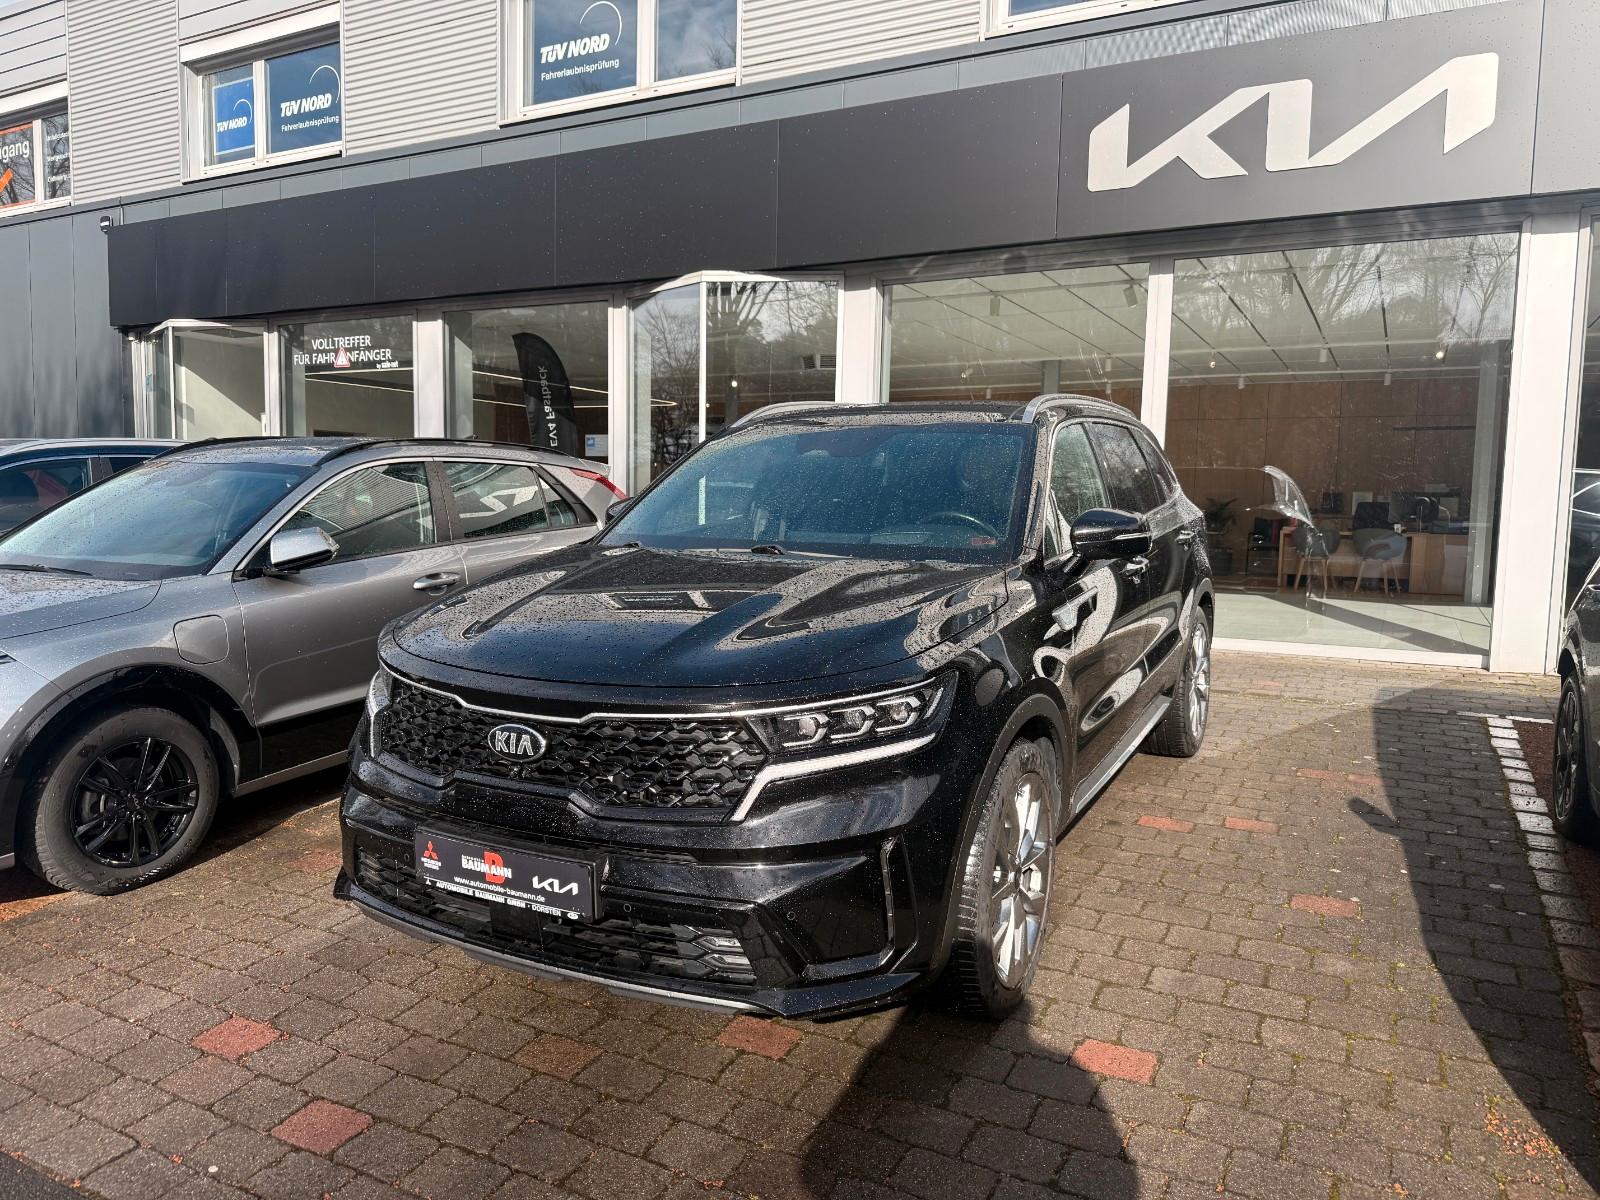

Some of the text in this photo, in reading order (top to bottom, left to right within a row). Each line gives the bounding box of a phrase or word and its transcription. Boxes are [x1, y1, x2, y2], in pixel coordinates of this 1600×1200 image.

[567, 34, 610, 58] NORD
[541, 59, 620, 81] Fahrerlaubnisprüfung
[300, 93, 332, 113] NORD
[228, 116, 248, 130] NORD
[281, 115, 340, 133] Fahrerlaubnisprüfung
[1088, 52, 1499, 192] KIA
[0, 140, 30, 163] gang
[311, 335, 371, 350] VOLLTREFFER
[293, 352, 310, 366] FÜR
[495, 730, 534, 756] KIA
[461, 857, 512, 879] BAUMANN
[453, 876, 546, 902] www.automobile-baumann.de
[532, 875, 579, 896] KIA
[435, 880, 474, 896] AUTOMOBILE
[474, 889, 505, 904] BAUMANN
[531, 903, 561, 917] DORSTEN
